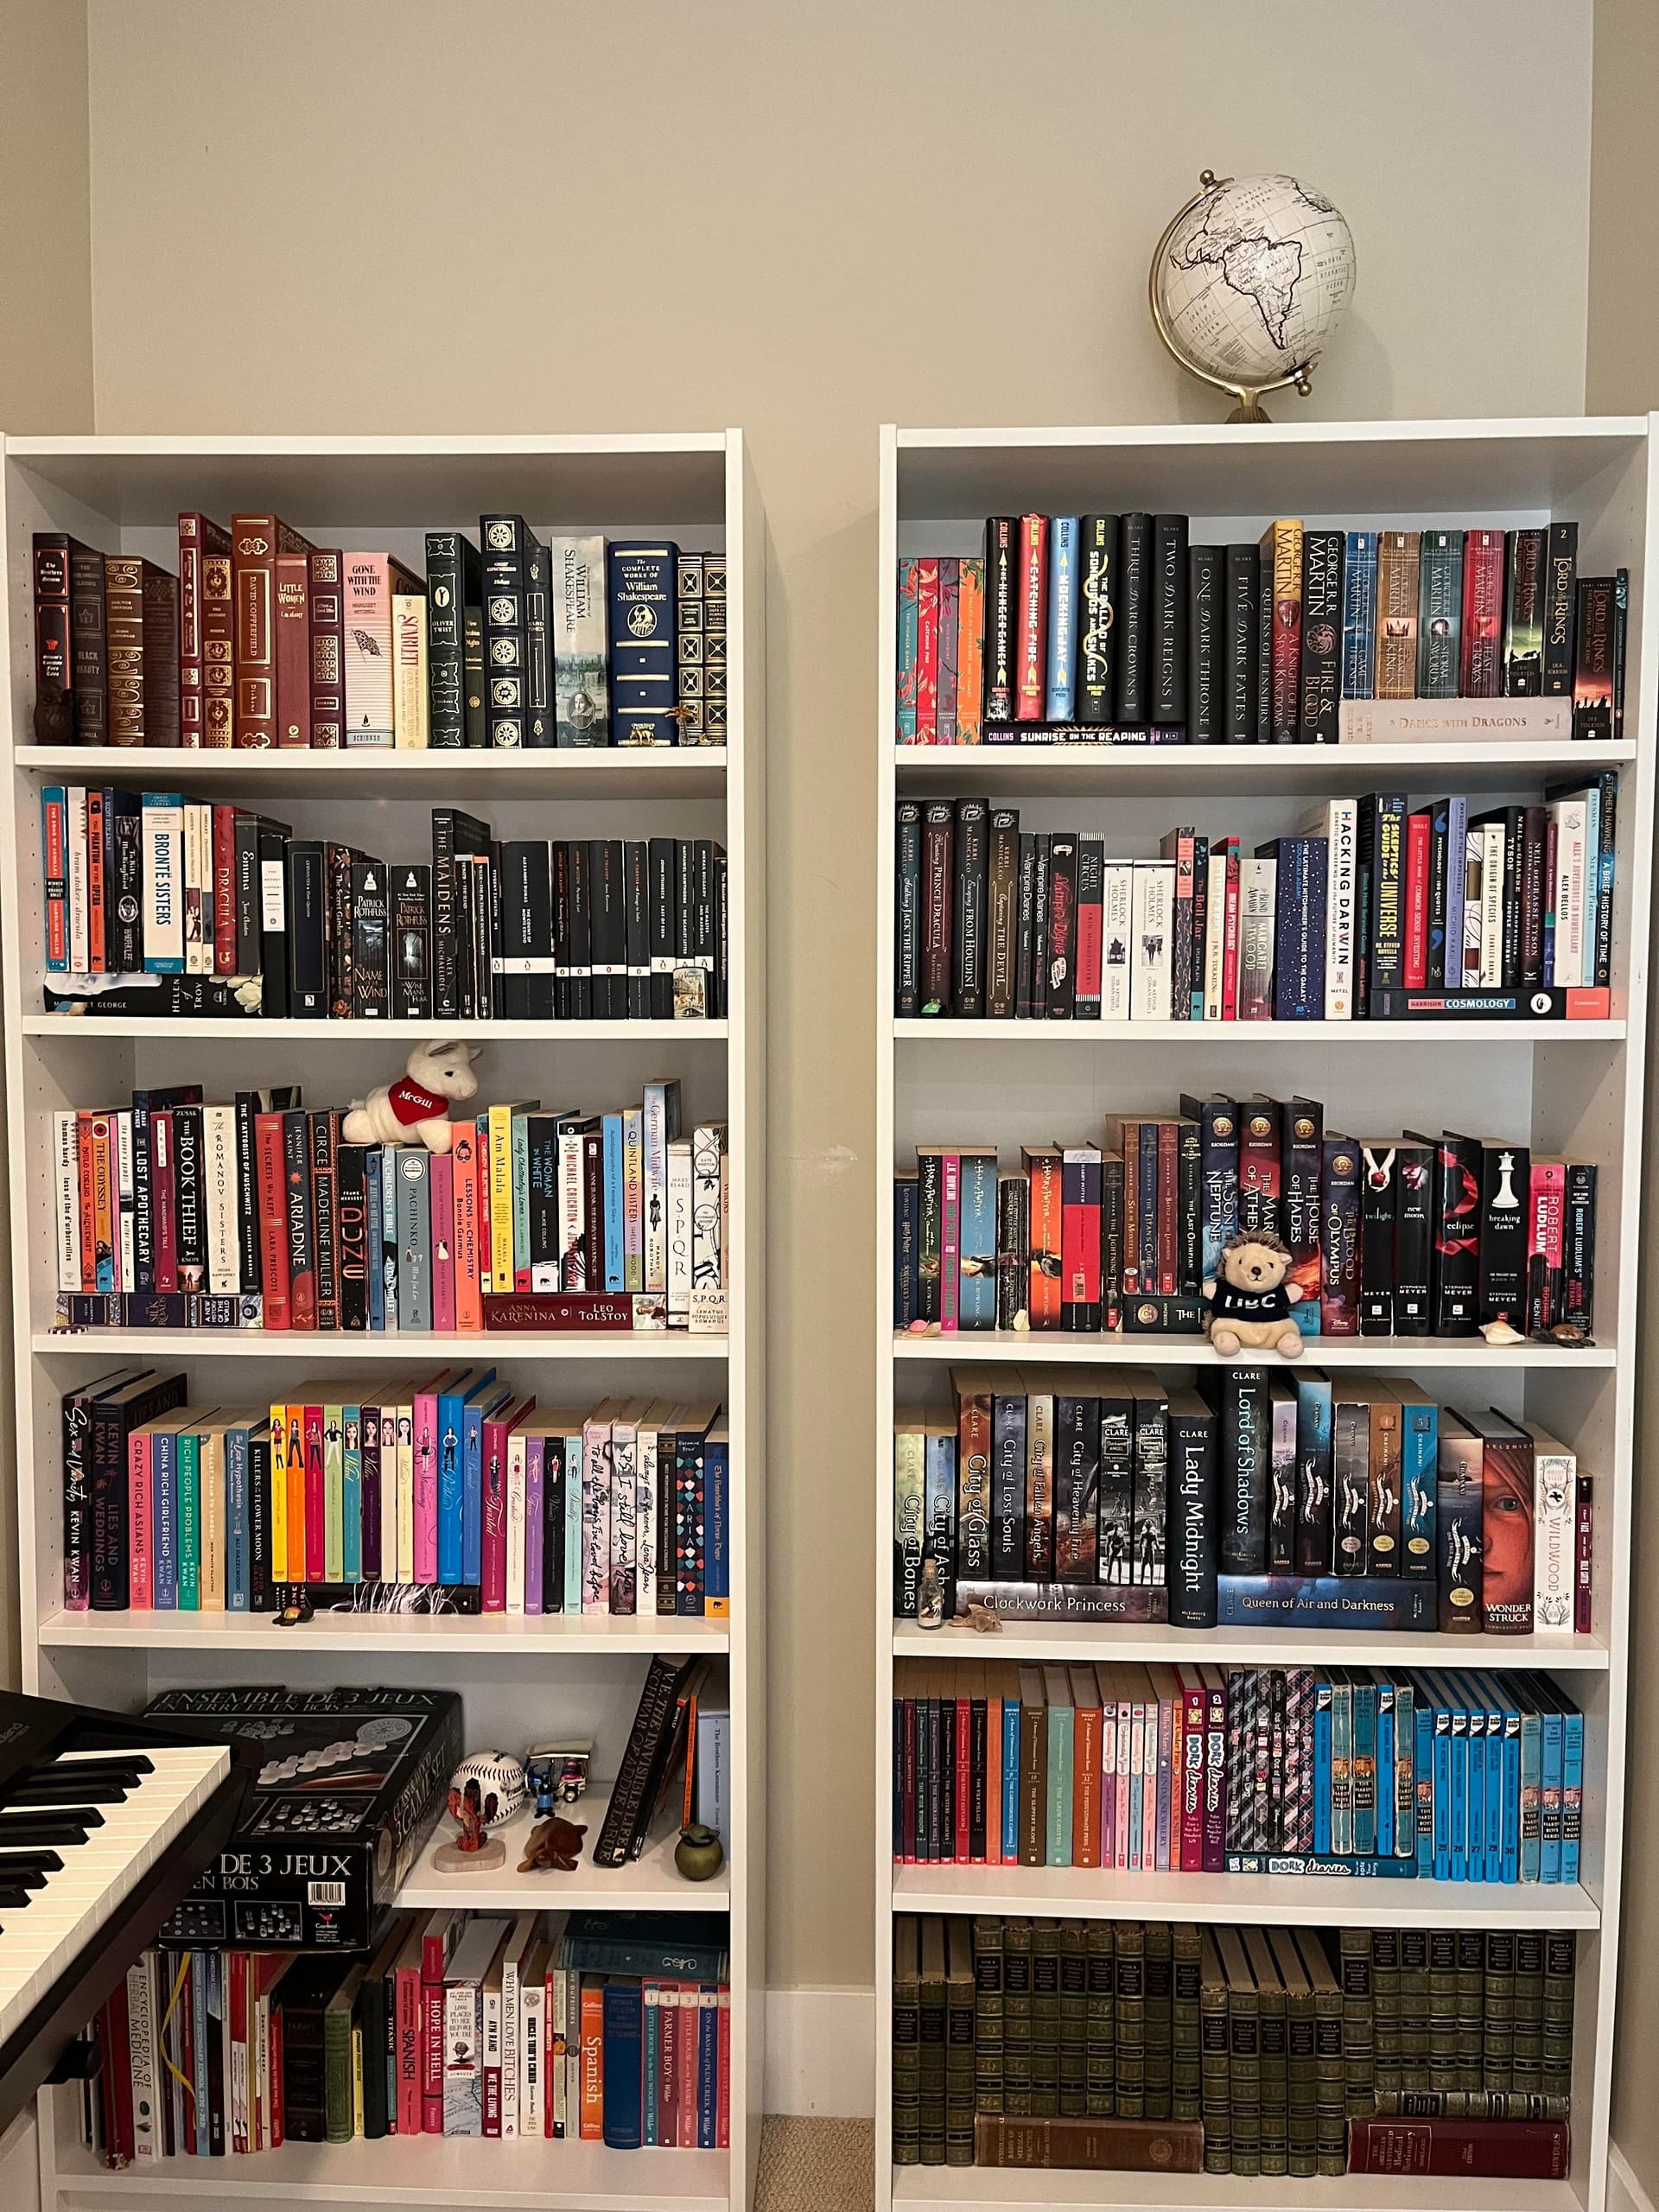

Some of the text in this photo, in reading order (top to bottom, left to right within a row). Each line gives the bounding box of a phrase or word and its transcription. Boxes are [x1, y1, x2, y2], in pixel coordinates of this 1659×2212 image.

[1000, 522, 1008, 549] COLLINS
[1560, 530, 1567, 539] 2
[279, 583, 303, 593] LITTLE
[347, 576, 381, 585] WITH THE
[353, 588, 376, 596] WIND
[564, 550, 575, 634] SHAKESPEARE
[575, 563, 586, 620] WILLIAM
[617, 592, 667, 601] Shakespeare
[626, 582, 658, 591] William
[1310, 537, 1325, 617] MARTIN
[1027, 567, 1039, 663] CATCHING FIRE
[1058, 575, 1069, 663] MOCKINGJAY
[1161, 539, 1177, 696] TWO DARK REIGNS
[1305, 677, 1320, 728] BLOOD
[1320, 661, 1336, 717] FIRE &
[988, 732, 1014, 741] COLLINS
[1020, 732, 1066, 741] SUNRISE
[1098, 732, 1146, 741] REAPING
[154, 834, 172, 881] BRONTË
[1089, 856, 1097, 889] NIGHT
[217, 868, 229, 927] DRACULA
[358, 896, 385, 908] PATRICK
[436, 830, 451, 935] THE MAIDENS
[1338, 811, 1351, 964] HACKING DARWIN
[1601, 872, 1610, 894] BRIEF
[156, 883, 171, 926] SISTERS
[354, 906, 387, 918] ROTHFUSS
[1379, 882, 1398, 938] UNIVERSE
[1600, 898, 1609, 932] HISTORY
[901, 930, 912, 949] THE
[964, 907, 975, 988] FROM HOUDINI
[1600, 934, 1608, 943] OF
[902, 951, 912, 988] RIPPER
[172, 979, 181, 1013] HELEN
[194, 982, 203, 1009] TROY
[358, 986, 387, 999] WIND
[1446, 1000, 1510, 1008] COSMOLOGY
[294, 1126, 303, 1166] JENNIFER
[315, 1125, 328, 1166] CIRCE
[137, 1150, 150, 1264] LOST APOTHECARY
[180, 1136, 196, 1246] BOOK THIEF
[465, 1179, 474, 1222] LESSONS
[1287, 1175, 1304, 1243] OF HADES
[1306, 1176, 1319, 1244] THE HOUSE
[289, 1192, 306, 1267] ARIADNE
[317, 1177, 332, 1297] MADELINE MILLER
[409, 1188, 418, 1247] PACHINKO
[1446, 1221, 1475, 1236] eclipse
[1489, 1215, 1521, 1225] breaking
[1535, 1196, 1548, 1253] LUDLUM
[1548, 1196, 1559, 1252] ROBERT
[466, 1229, 474, 1280] CHEMISTRY
[578, 1311, 628, 1321] TOLSTOY
[594, 1304, 614, 1313] LEO
[1179, 1430, 1210, 1439] CLARE
[963, 1455, 987, 1495] City
[1236, 1388, 1255, 1534] Lord of Shadows
[1179, 1446, 1205, 1593] Lady Midnight
[70, 1510, 80, 1584] KEVIN KWAN
[969, 1518, 985, 1568] Glass
[1548, 1516, 1560, 1592] WILDWOOD
[983, 1595, 1126, 1611] Clockwork Princess
[1242, 1597, 1395, 1611] Queen of Air and Darkness
[1486, 1603, 1531, 1612] WONDER
[1489, 1612, 1529, 1623] STRUCK
[1213, 1695, 1222, 1704] 2
[220, 1853, 353, 1876] DE 3 JEUX
[222, 1876, 259, 1891] BOIS
[1272, 1860, 1351, 1873] DORK diaries
[139, 1974, 151, 2088] ENCYCLOPEDIA OF
[431, 2000, 442, 2082] HOPE IN HELL
[488, 2020, 498, 2053] AYN RAND
[505, 1971, 516, 2101] WHY MEN LOVE BITCHES
[664, 2012, 673, 2077] FARMER BOY
[582, 2037, 602, 2104] Spanish
